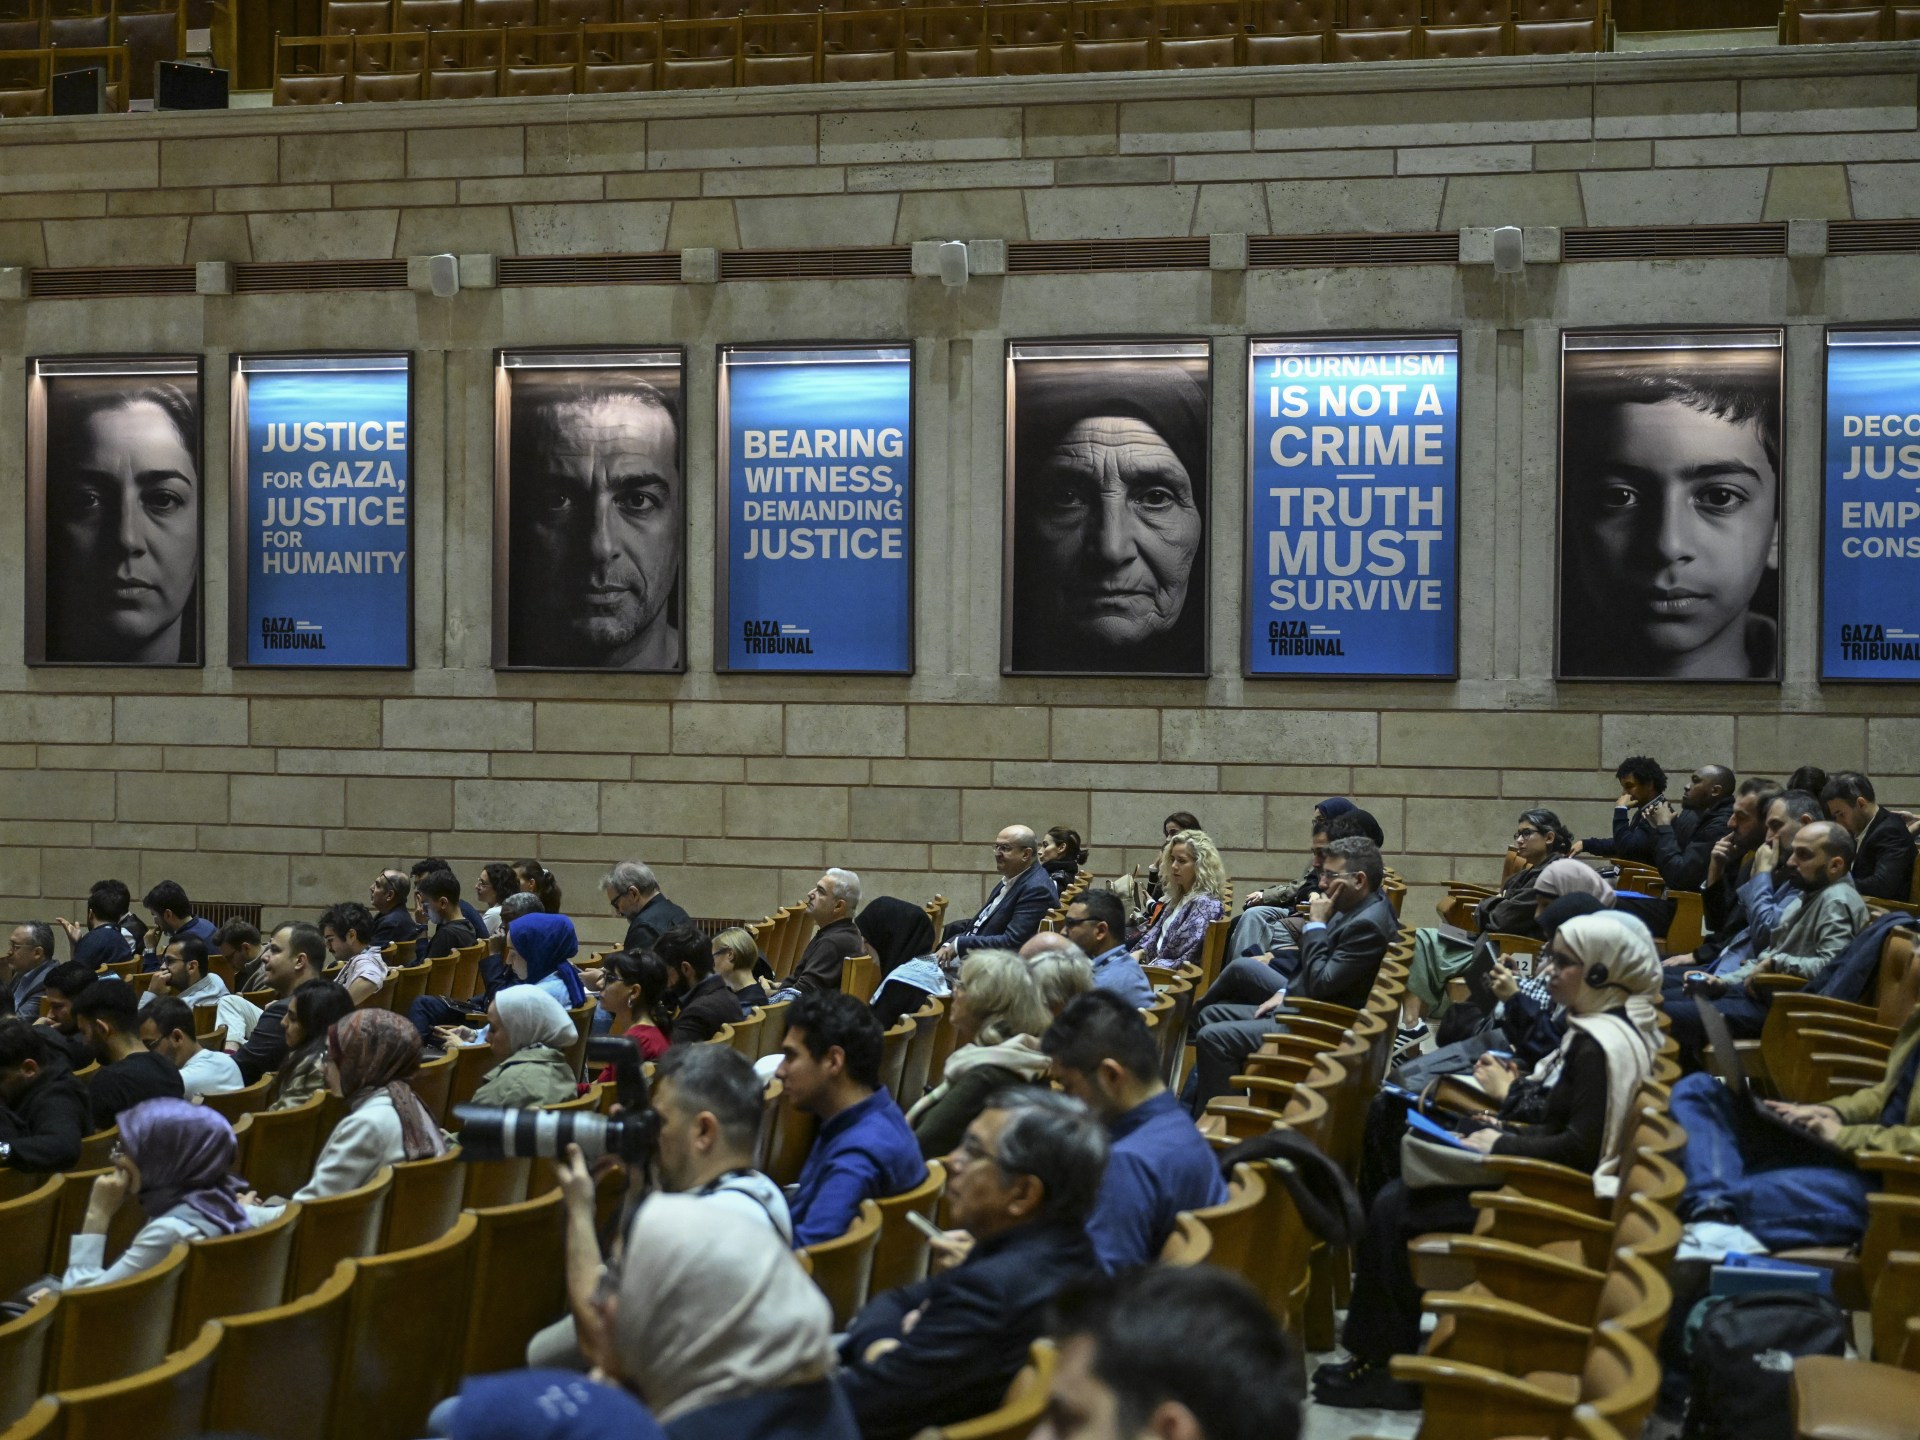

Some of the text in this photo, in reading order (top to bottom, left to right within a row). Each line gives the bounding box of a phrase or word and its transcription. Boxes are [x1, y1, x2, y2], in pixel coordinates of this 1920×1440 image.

[1271, 355, 1444, 378] JOURNALISM
[1270, 383, 1443, 418] IS NOT A
[262, 421, 406, 453] JUSTICE
[744, 428, 903, 458] BEARING
[1270, 424, 1444, 467] CRIME
[262, 460, 406, 493] FOR GAZA,
[744, 466, 903, 498] WITNESS,
[262, 496, 406, 527] JUSTICE
[743, 500, 903, 521] DEMANDING
[1269, 486, 1443, 527] TRUTH
[262, 531, 303, 548] FOR
[743, 528, 903, 560] JUSTICE
[262, 551, 406, 574] HUMANITY
[1268, 529, 1443, 577] MUST
[1269, 579, 1442, 611] SURVIVE
[262, 617, 295, 633] GAZA
[743, 620, 780, 637] GAZA
[1268, 621, 1309, 639] GAZA
[1841, 624, 1885, 642] GAZA
[262, 633, 326, 649] TRIBUNAL
[743, 637, 813, 654] TRIBUNAL
[1268, 639, 1345, 656] TRIBUNAL
[1841, 643, 1920, 661] TRIBUNAL
